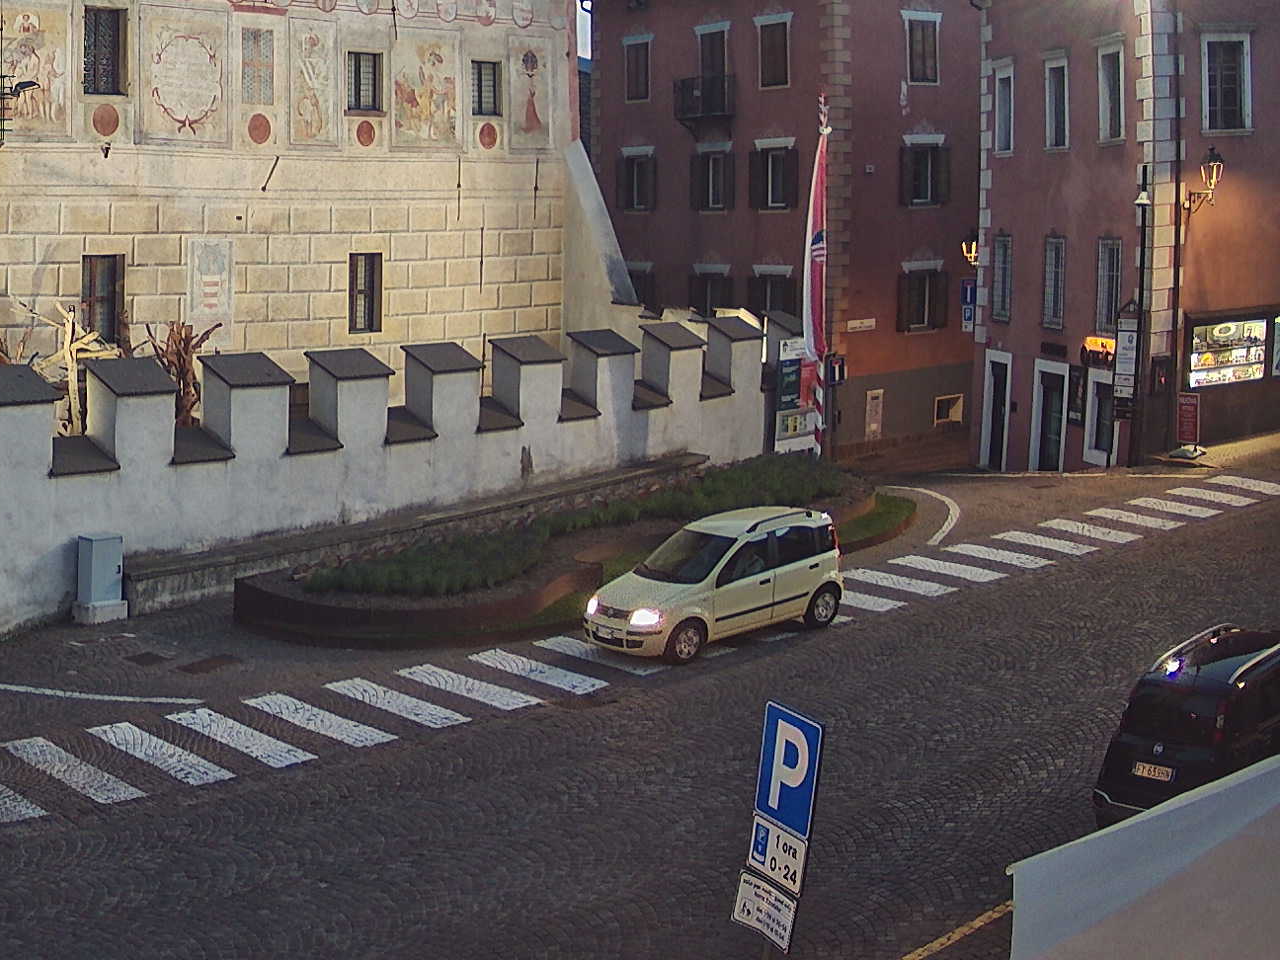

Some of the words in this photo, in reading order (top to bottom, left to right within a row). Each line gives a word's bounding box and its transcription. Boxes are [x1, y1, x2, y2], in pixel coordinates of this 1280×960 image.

[768, 719, 809, 810] P
[775, 834, 781, 849] 1
[782, 844, 797, 860] ora
